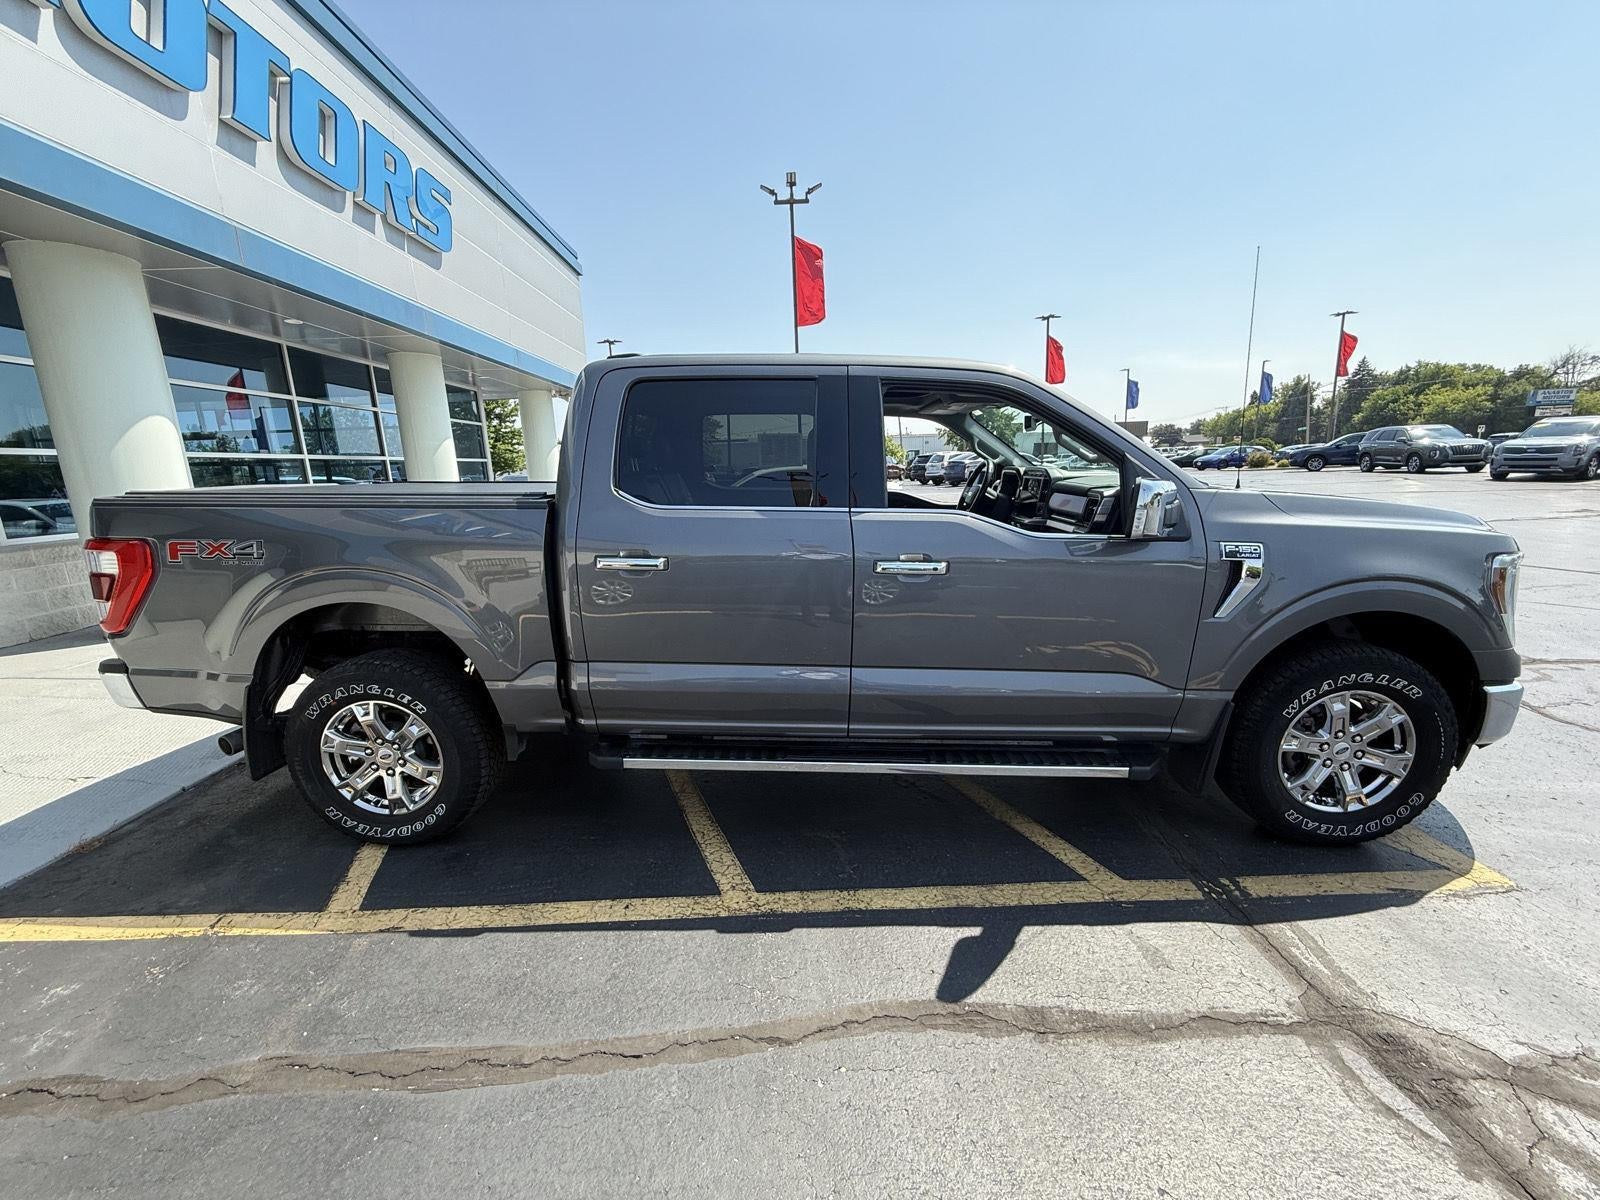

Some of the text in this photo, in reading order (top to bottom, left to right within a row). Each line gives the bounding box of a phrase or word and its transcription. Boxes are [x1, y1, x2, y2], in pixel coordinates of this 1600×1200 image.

[167, 539, 265, 564] FX4
[1225, 545, 1260, 553] F-150
[304, 683, 428, 720] WRANGLER
[1282, 672, 1424, 719] WRANGLER
[324, 803, 447, 838] GOODYEAR
[1284, 792, 1425, 837] GOODYEAR
